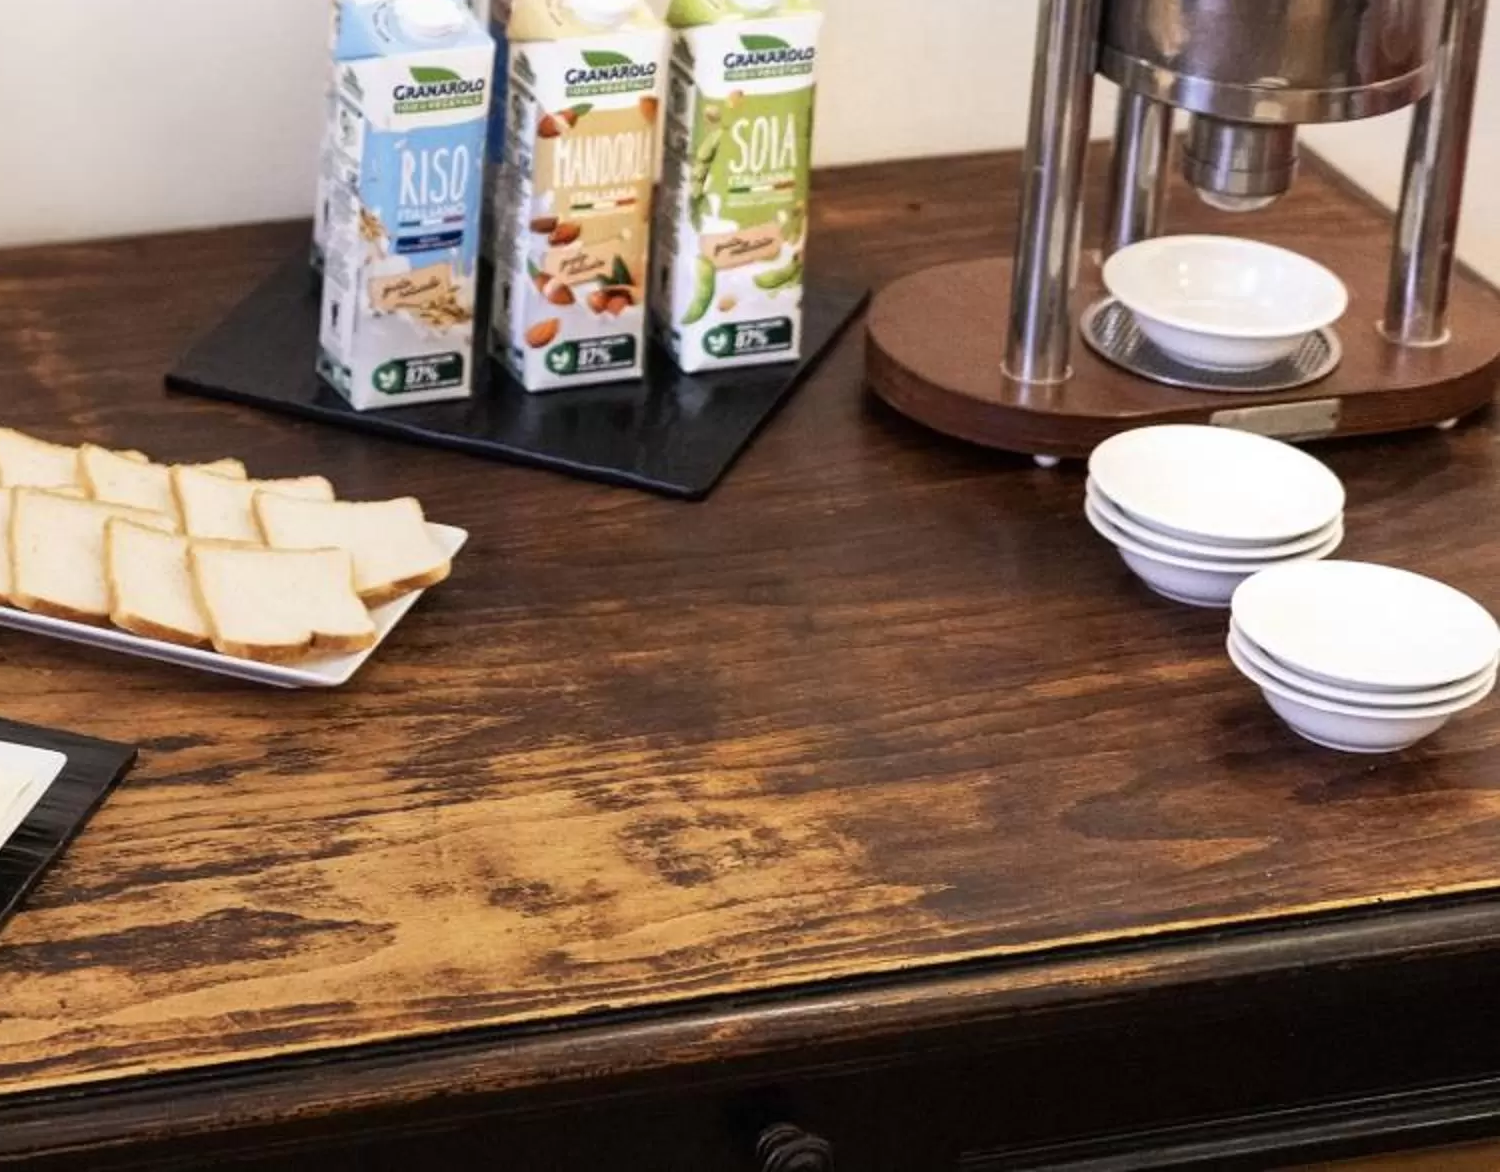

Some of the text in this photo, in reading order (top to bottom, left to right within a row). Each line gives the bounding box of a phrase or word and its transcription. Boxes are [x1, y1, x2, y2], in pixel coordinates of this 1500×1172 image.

[723, 46, 815, 69] GRANAROLO
[565, 62, 657, 85] GRANAROLO
[393, 78, 485, 101] GRANAROLO
[728, 112, 797, 174] SOIA
[399, 144, 470, 206] RISO
